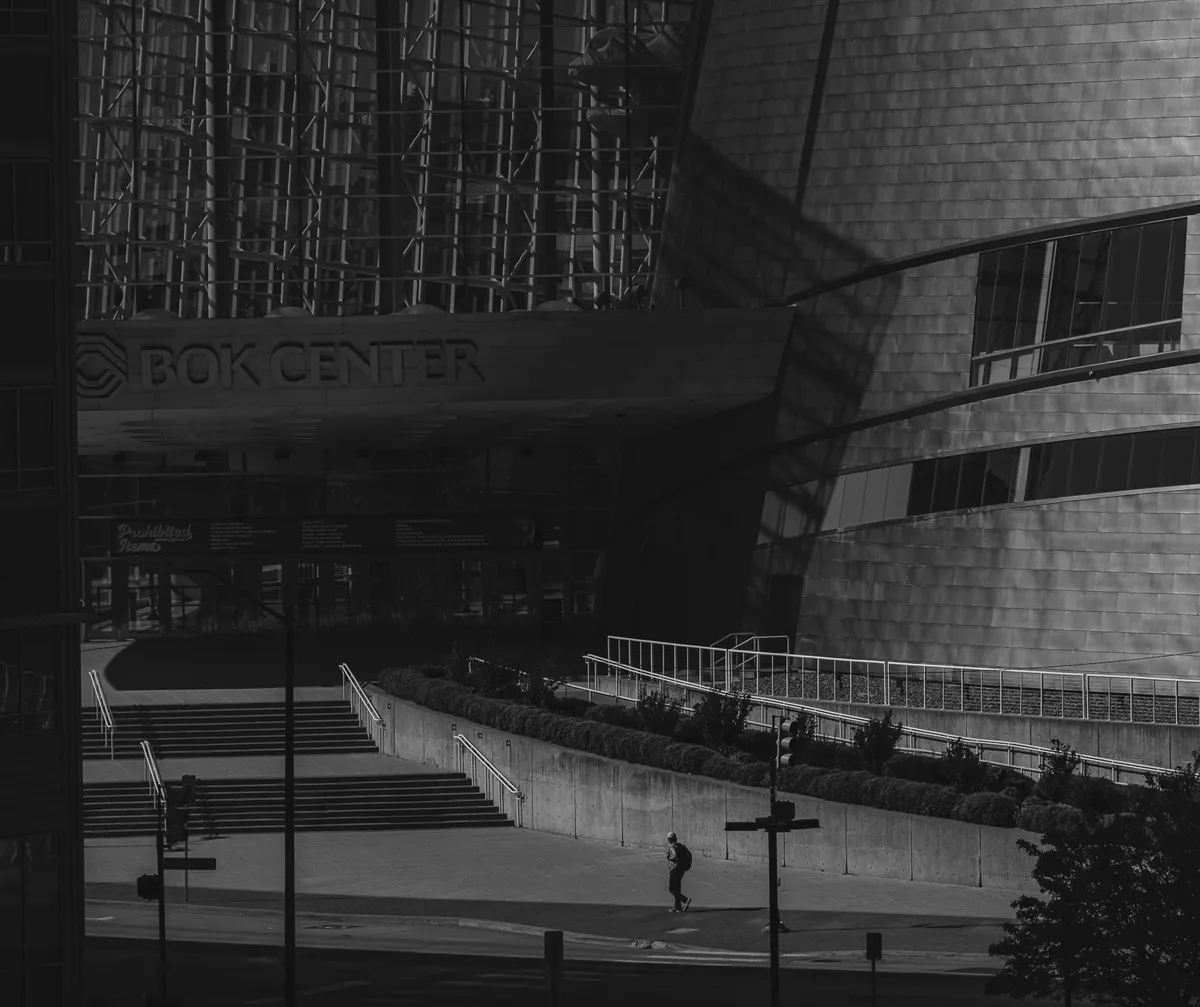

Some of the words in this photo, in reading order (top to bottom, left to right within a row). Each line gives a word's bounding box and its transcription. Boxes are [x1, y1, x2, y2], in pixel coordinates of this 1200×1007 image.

[138, 342, 258, 390] BOK
[267, 338, 485, 386] CENTER
[117, 524, 192, 542] Prohibited
[117, 538, 161, 553] Items
